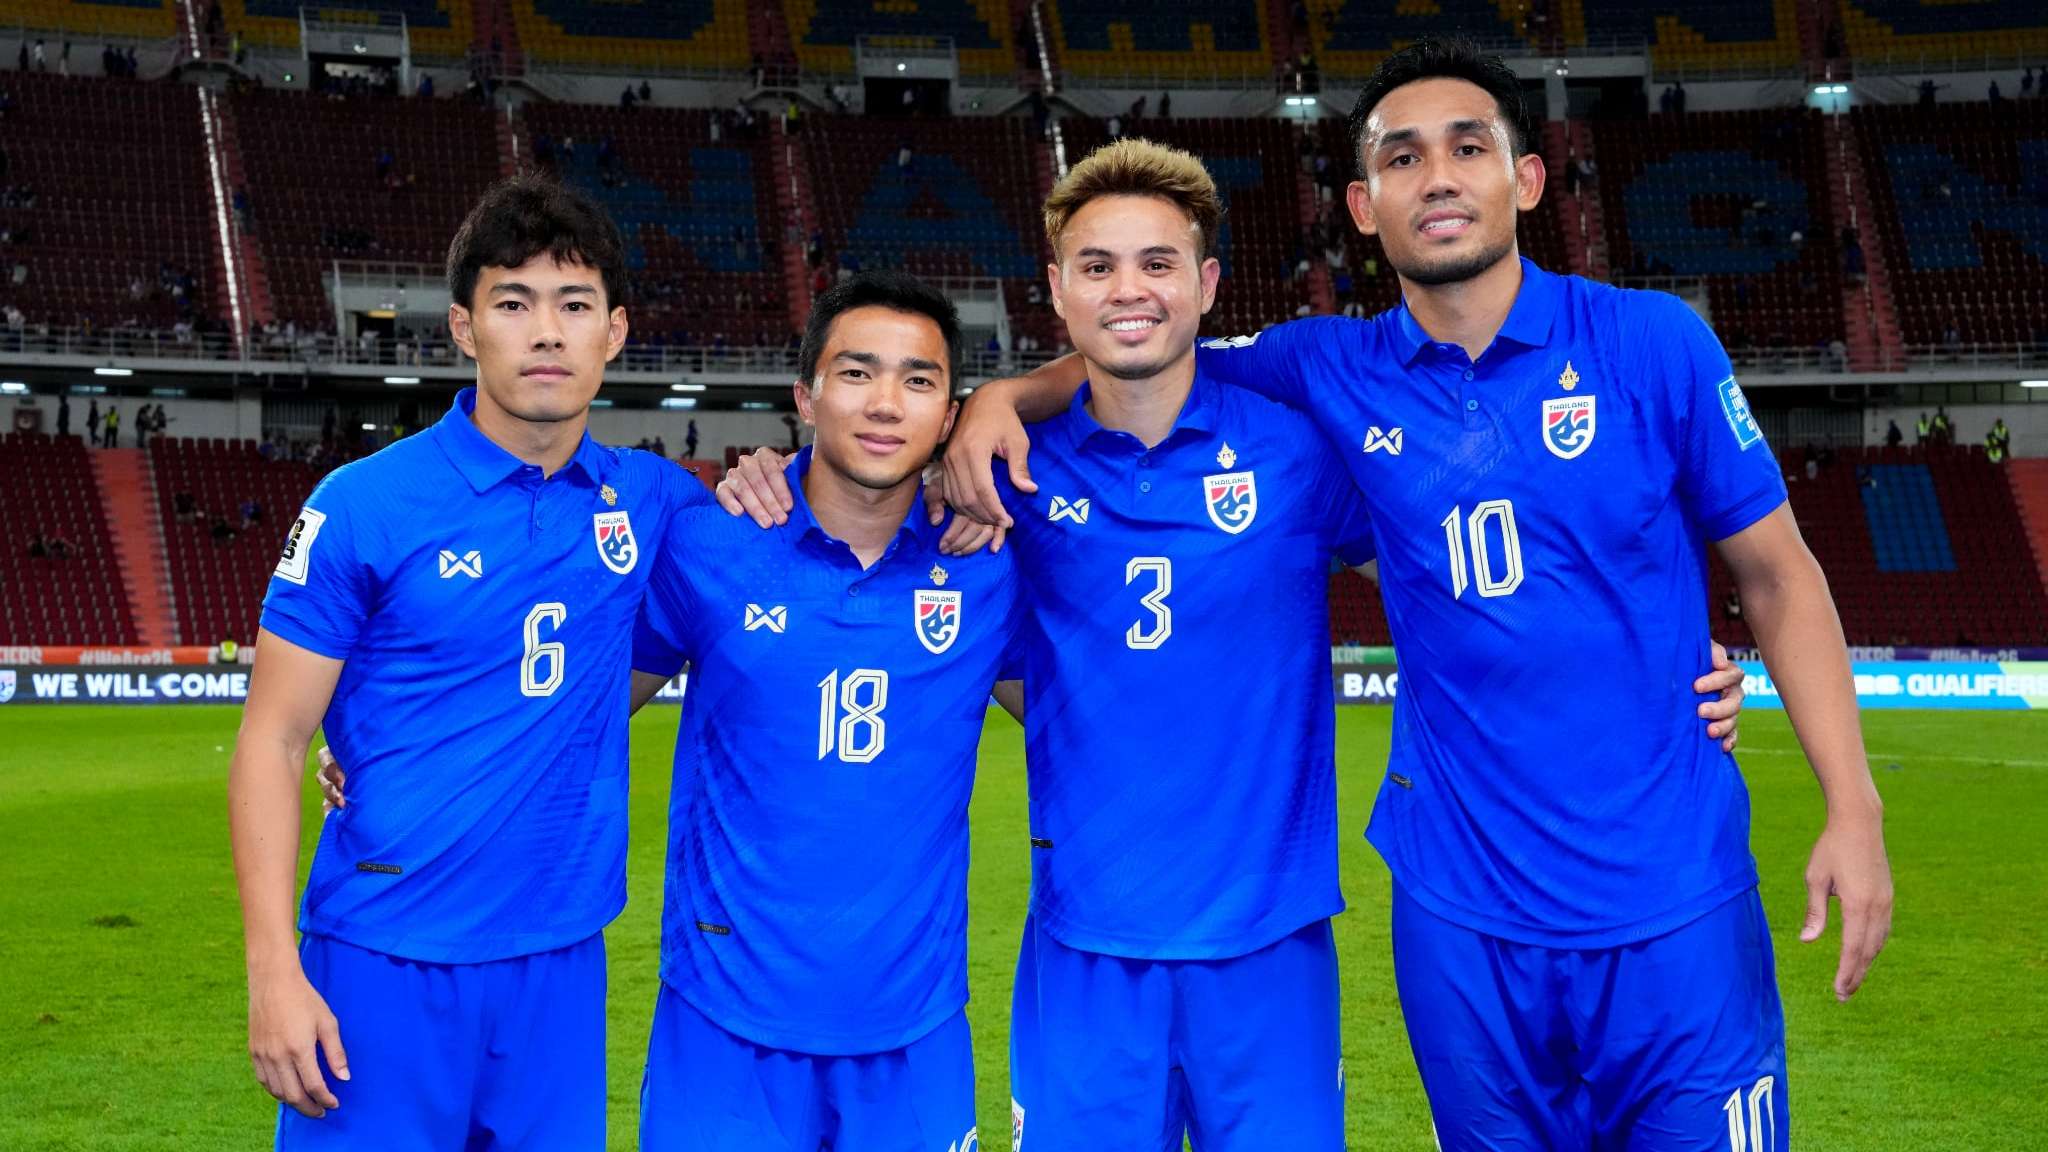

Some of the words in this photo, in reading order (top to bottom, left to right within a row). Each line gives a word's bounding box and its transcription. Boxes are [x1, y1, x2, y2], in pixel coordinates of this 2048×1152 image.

[1549, 401, 1589, 411] THAILAND
[1210, 477, 1248, 487] THAILAND
[598, 517, 625, 526] THAILAND
[1440, 499, 1524, 600] 10
[920, 595, 956, 603] THAILAND
[1126, 556, 1172, 650] 3
[520, 602, 567, 697] 6
[32, 673, 78, 697] WE
[85, 673, 155, 697] WILL
[158, 673, 248, 697] COME
[1343, 673, 1399, 697] BAC
[1907, 674, 2048, 697] QUALIFIERS
[816, 668, 889, 763] 18
